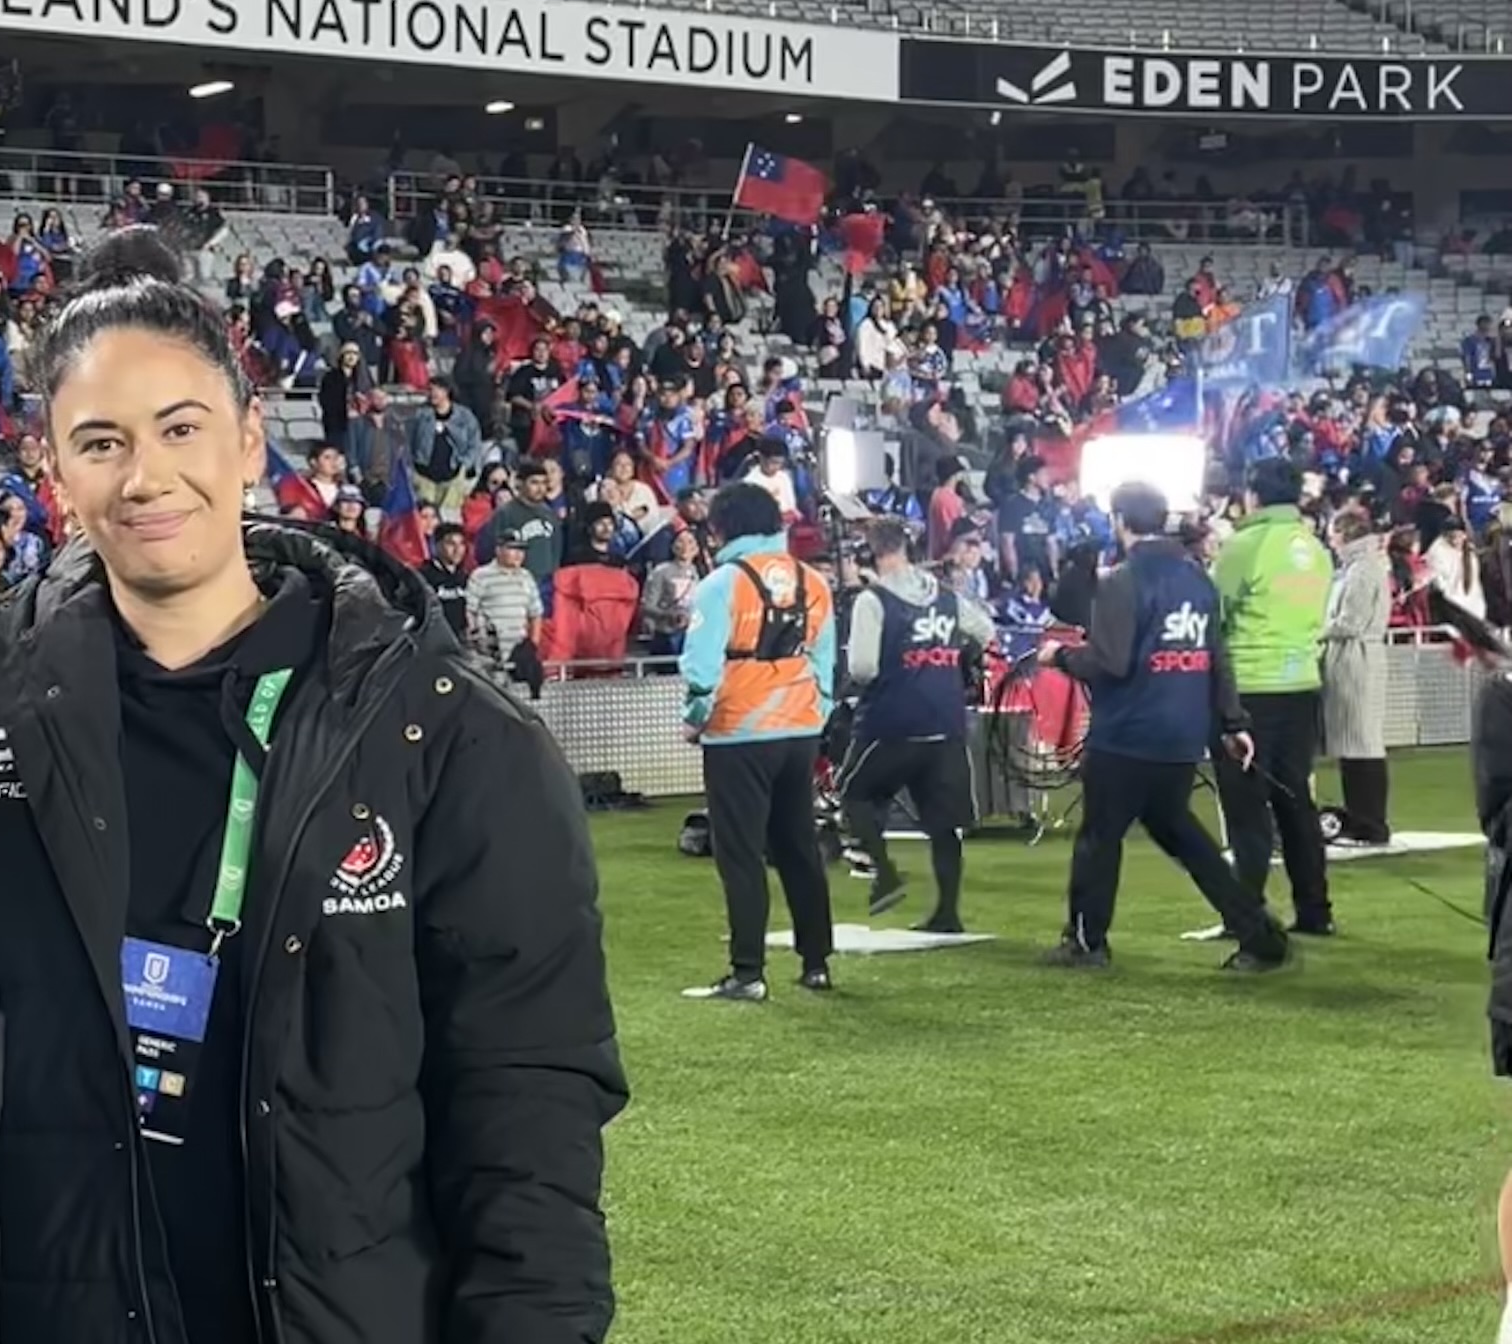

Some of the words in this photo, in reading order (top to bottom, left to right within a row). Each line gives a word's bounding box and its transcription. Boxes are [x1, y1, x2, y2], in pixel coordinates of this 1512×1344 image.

[584, 18, 813, 83] STADIUM
[1104, 57, 1269, 108] EDEN
[1293, 64, 1464, 110] PARK
[912, 606, 956, 645] sky
[1161, 601, 1209, 647] sky
[322, 891, 406, 914] SAMOA
